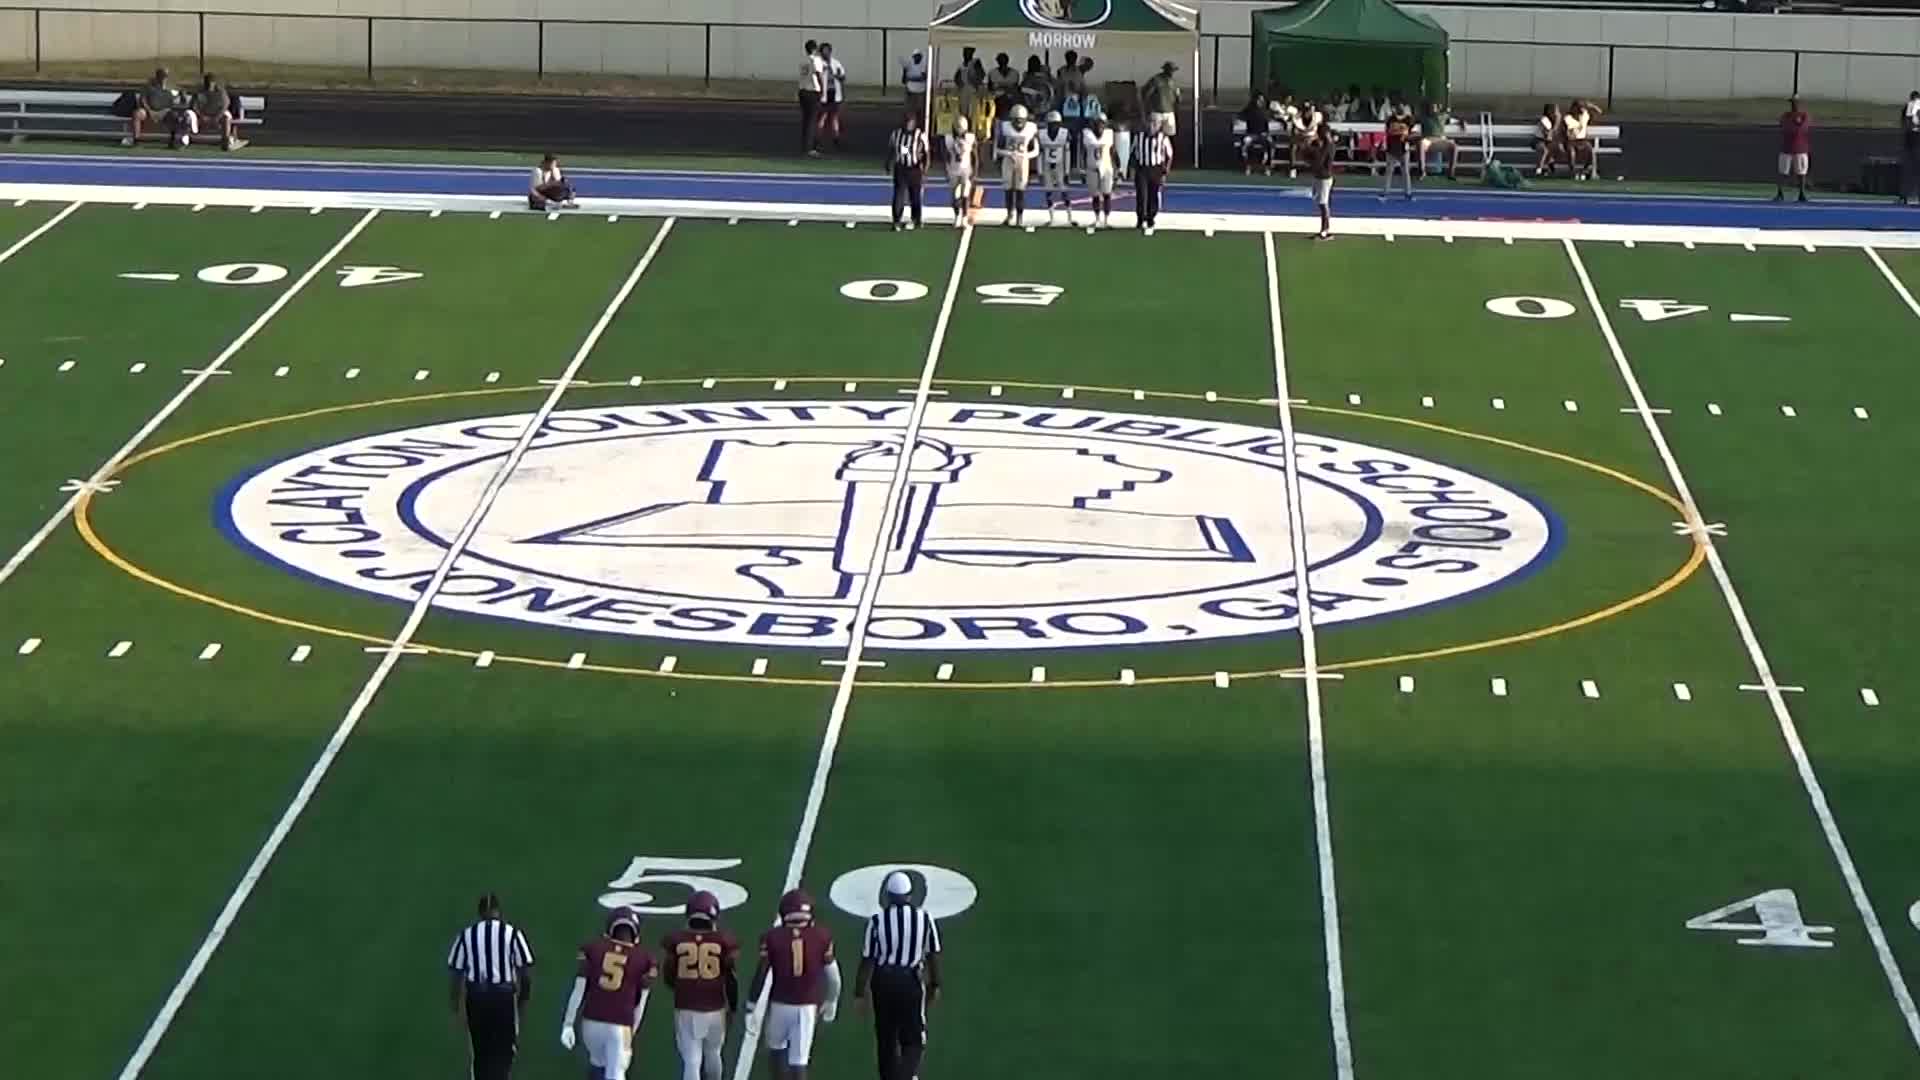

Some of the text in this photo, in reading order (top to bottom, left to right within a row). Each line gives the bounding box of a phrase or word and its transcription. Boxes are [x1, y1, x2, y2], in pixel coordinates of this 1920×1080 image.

[1029, 32, 1096, 48] MORROW
[267, 405, 1512, 573] CLAYTON COUNTY PUBLIC SCHOOLS
[1198, 588, 1386, 620] GA
[600, 952, 627, 991] 5
[676, 942, 722, 979] 26
[791, 938, 804, 977] 1
